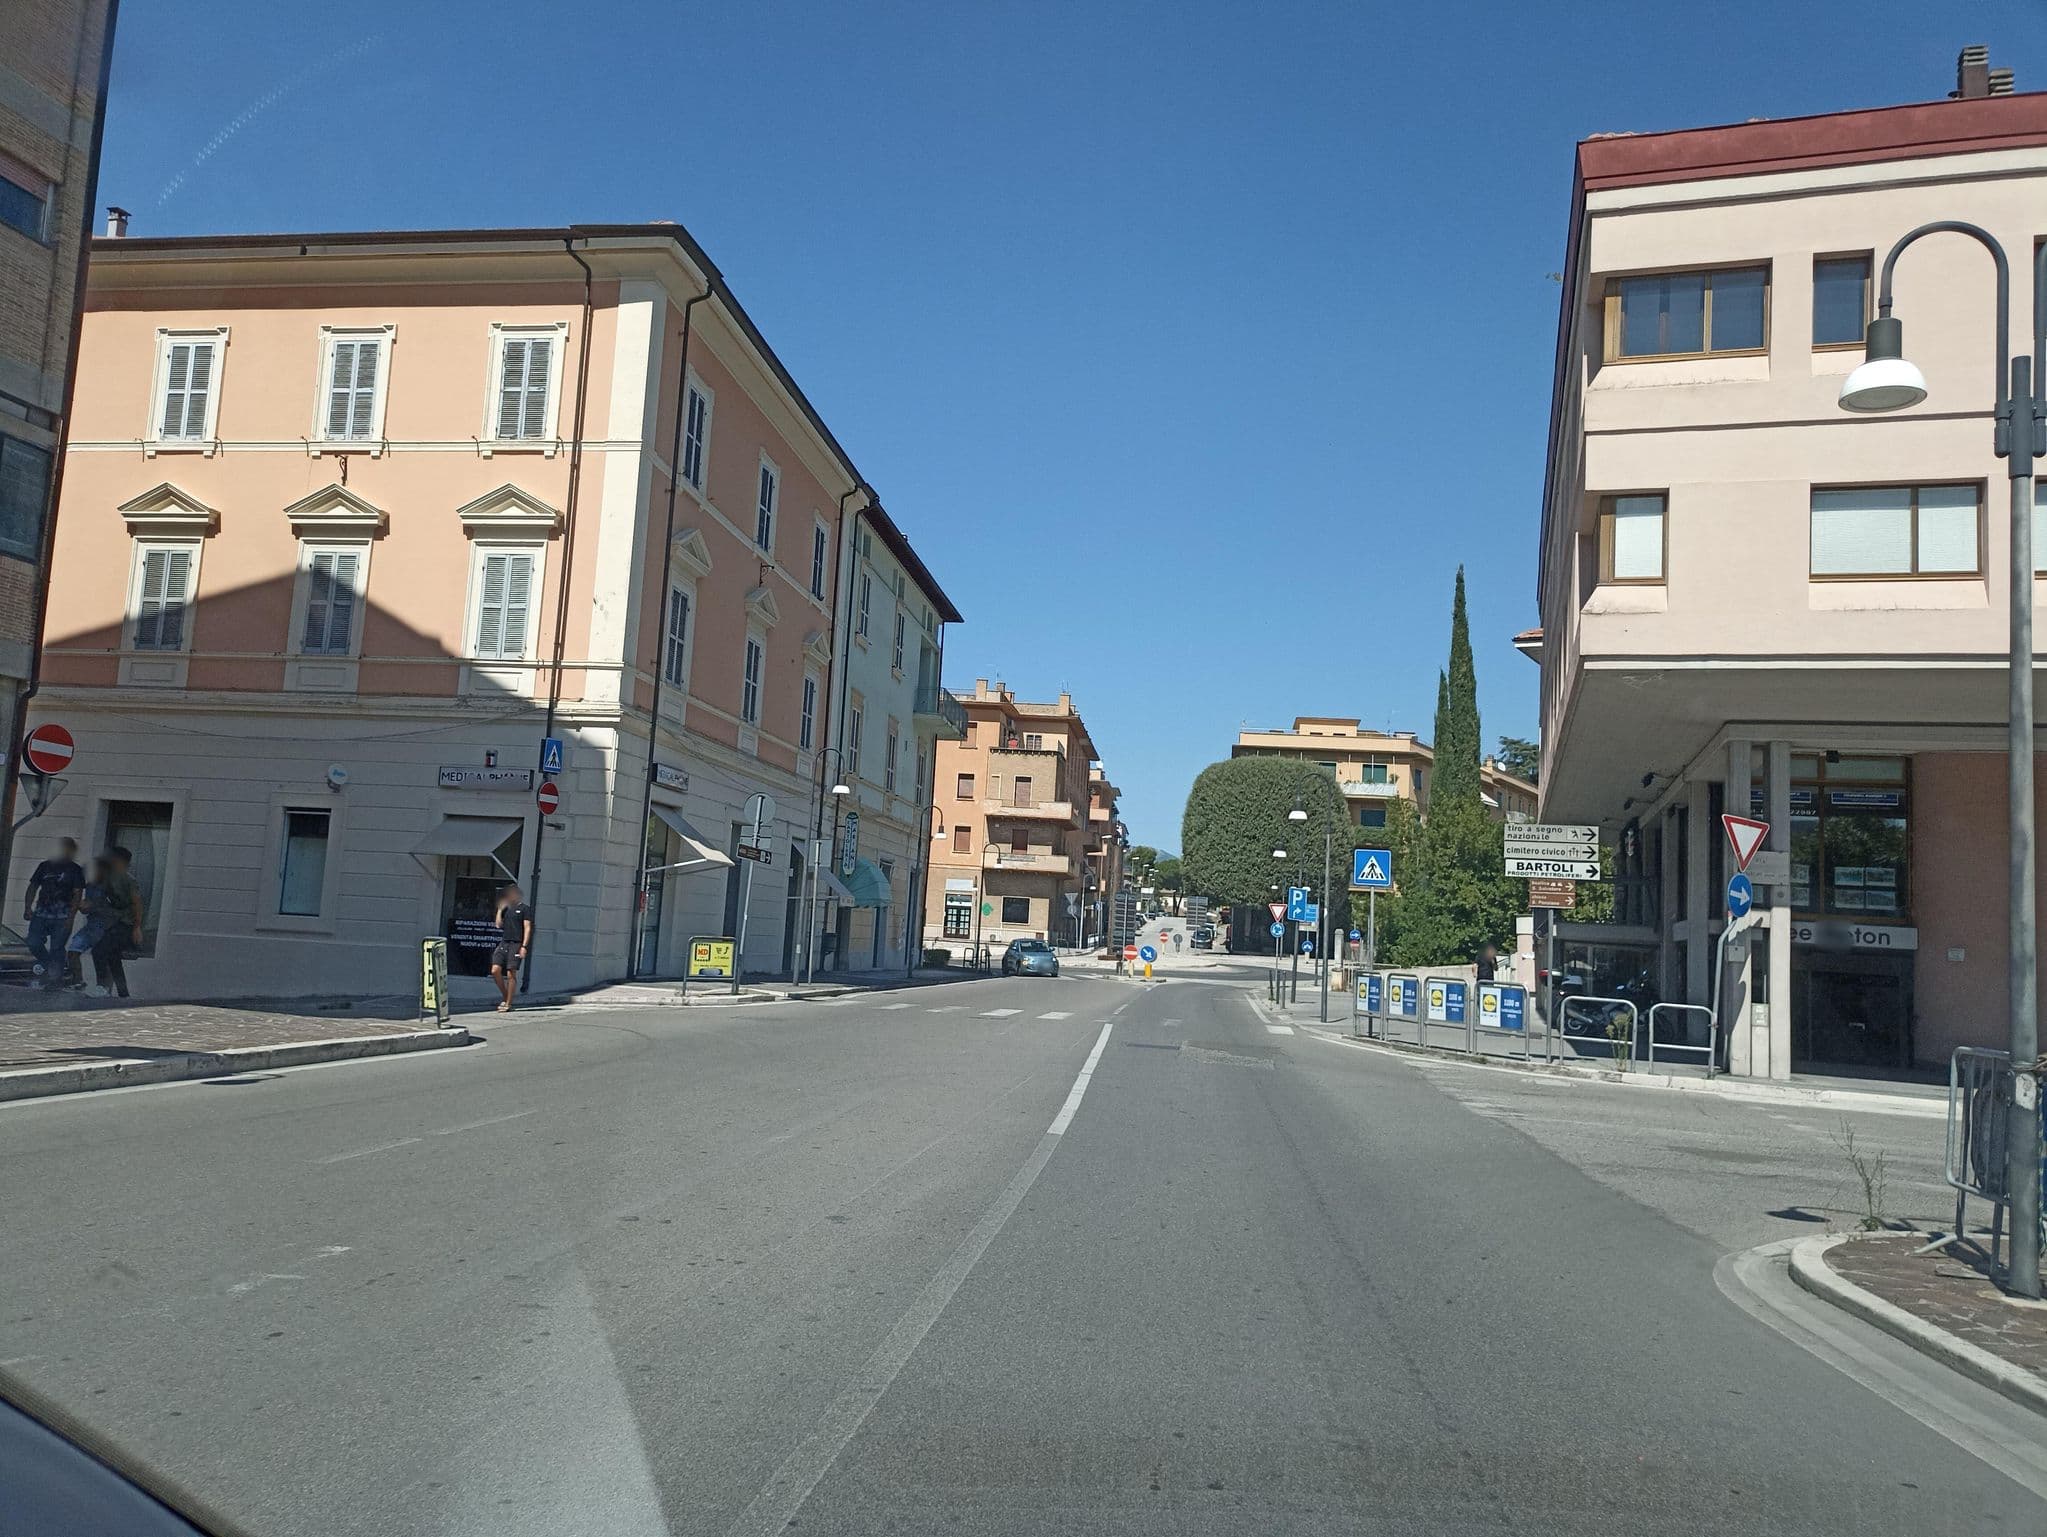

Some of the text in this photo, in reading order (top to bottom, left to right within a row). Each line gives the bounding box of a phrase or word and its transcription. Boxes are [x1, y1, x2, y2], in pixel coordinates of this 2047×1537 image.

[1506, 847, 1566, 856] cimitero civico
[1516, 862, 1574, 873] BARTOLI
[1293, 890, 1303, 906] P
